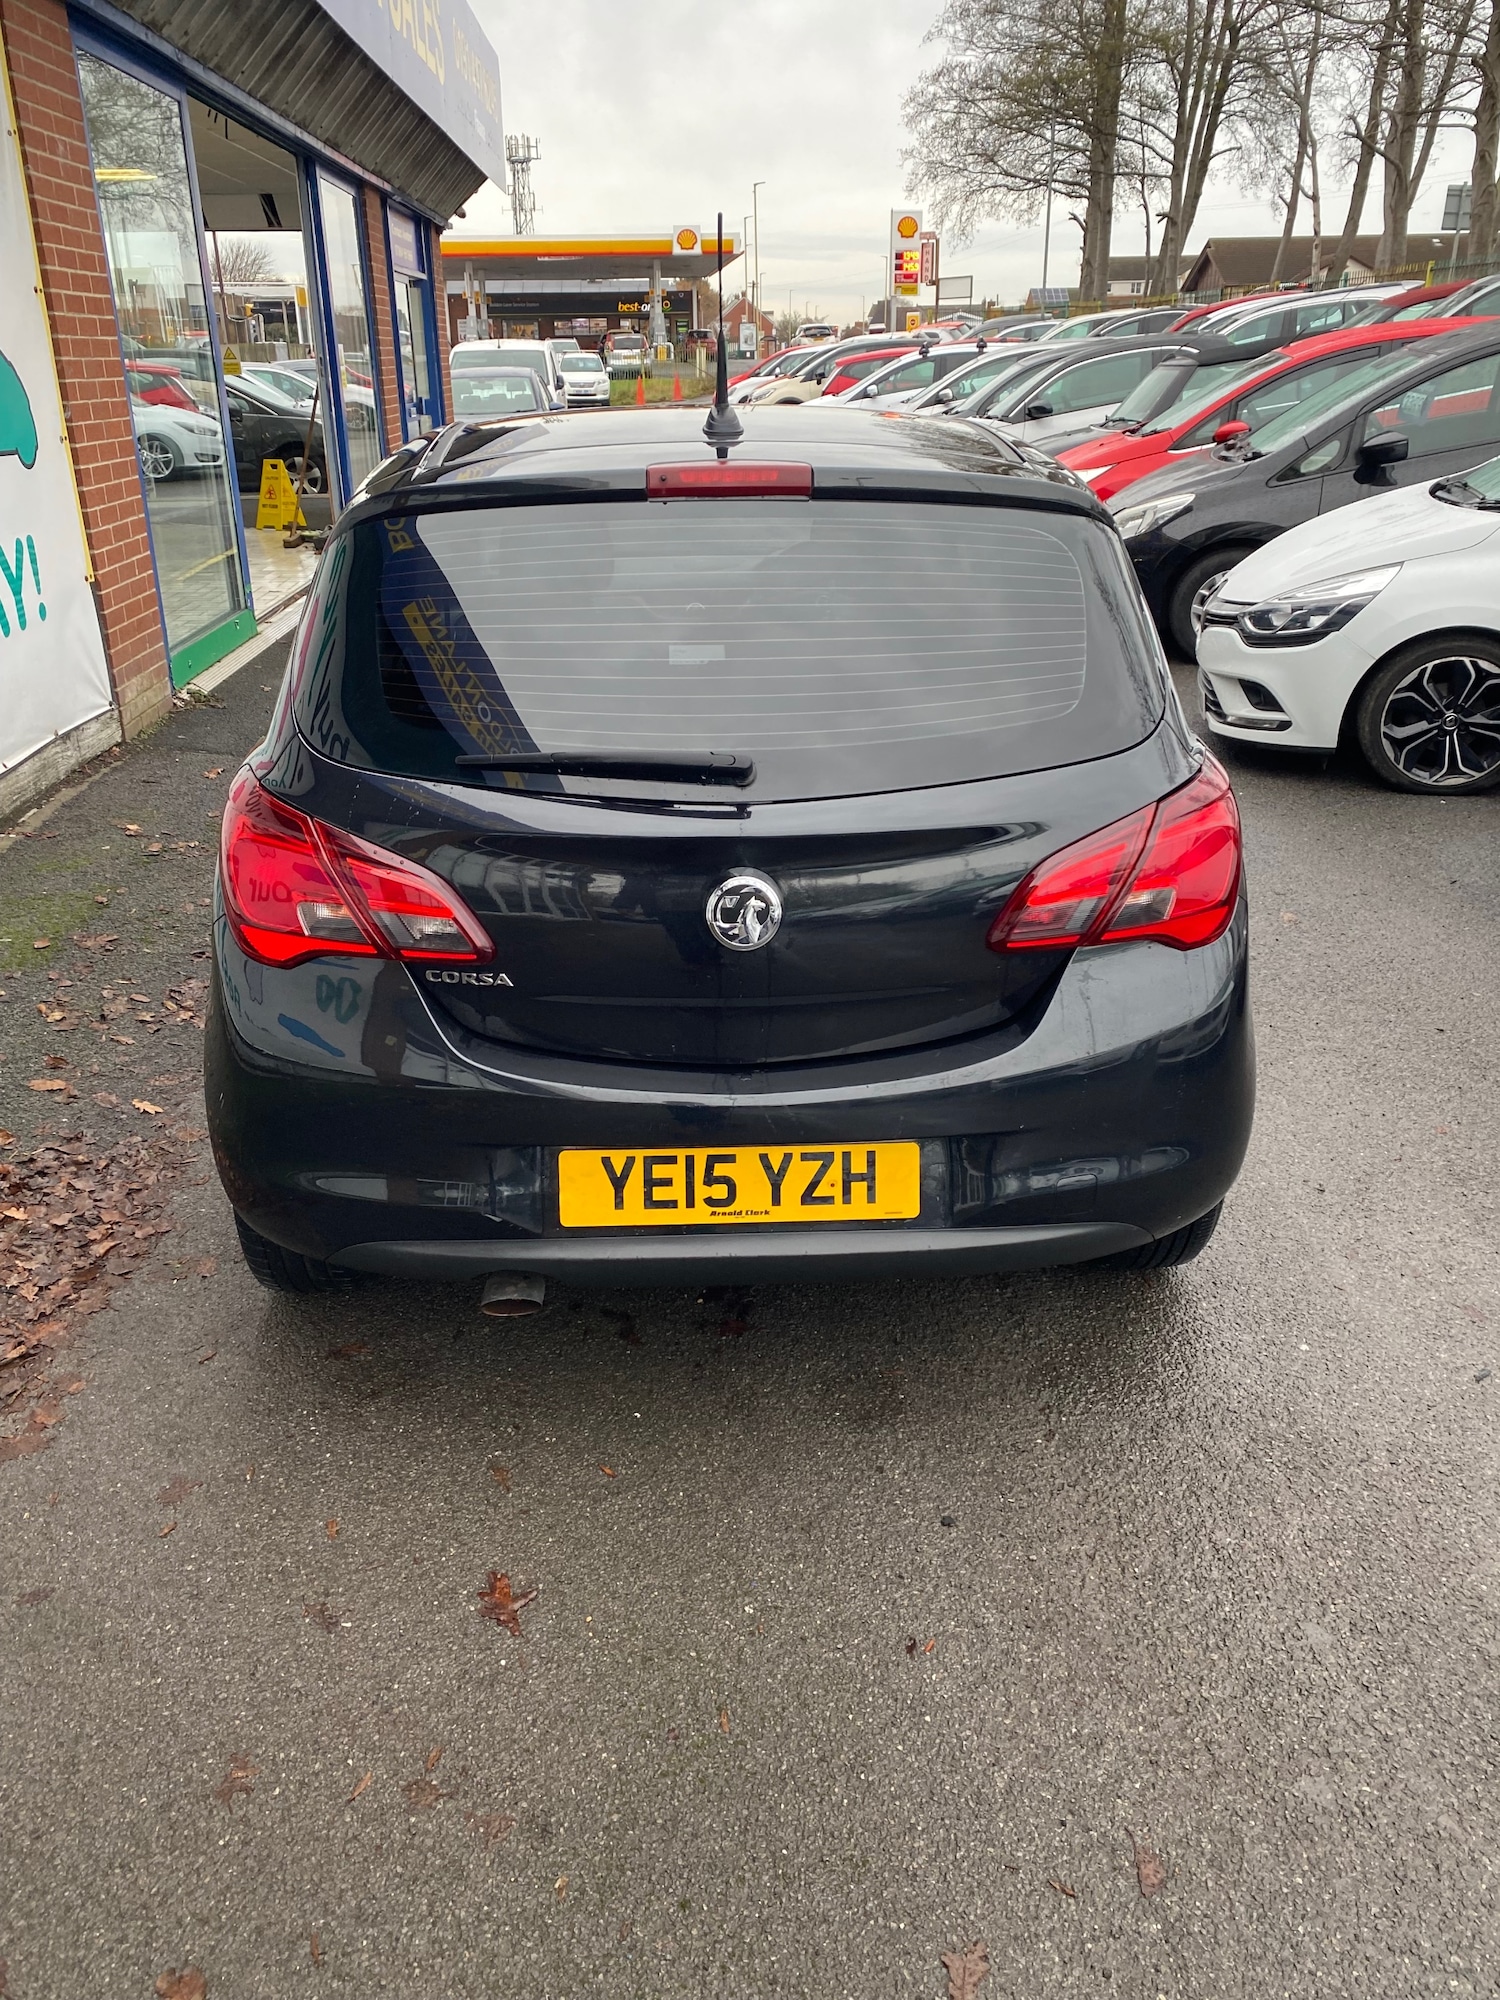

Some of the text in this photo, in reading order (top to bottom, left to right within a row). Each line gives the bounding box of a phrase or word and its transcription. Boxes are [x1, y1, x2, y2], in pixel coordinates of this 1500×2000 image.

[617, 301, 651, 311] best-o
[425, 970, 514, 987] CORSA
[601, 1150, 877, 1210] YE15 YZH
